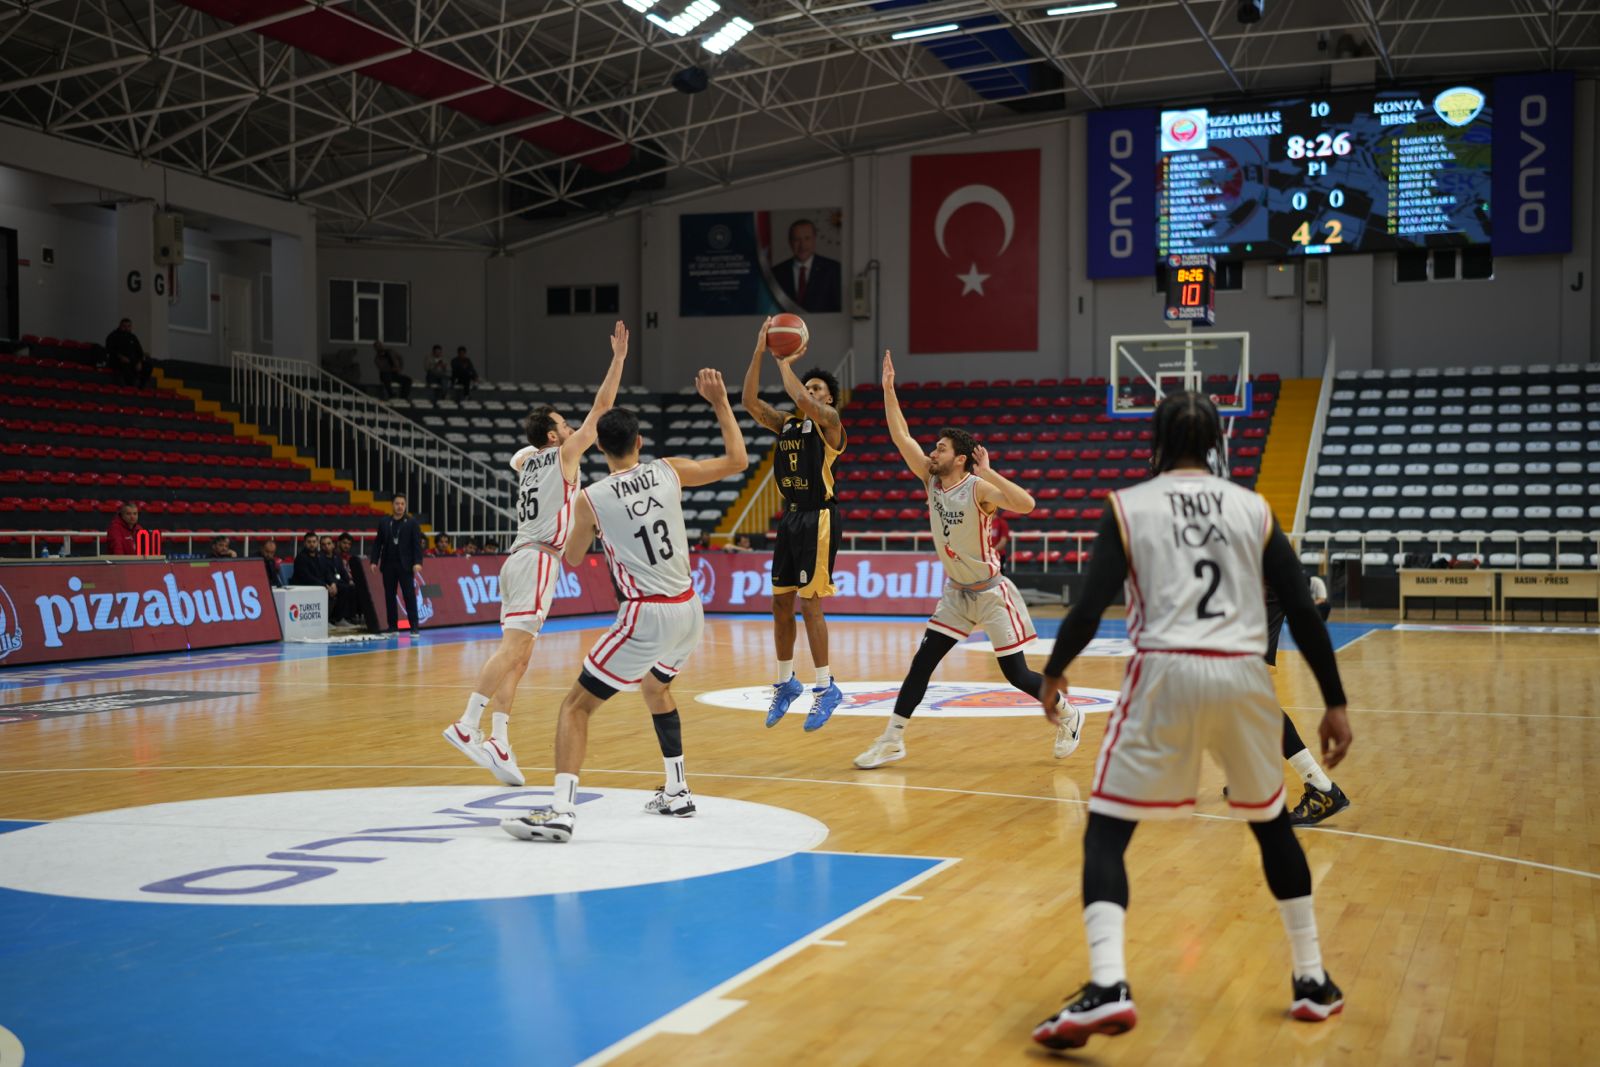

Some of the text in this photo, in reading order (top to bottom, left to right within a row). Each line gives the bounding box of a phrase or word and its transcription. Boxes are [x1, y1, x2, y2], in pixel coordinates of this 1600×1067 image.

[1310, 102, 1330, 117] 10
[1374, 100, 1424, 113] KONYA
[1381, 113, 1416, 126] BBSK
[1234, 123, 1282, 138] OSMAN
[1287, 132, 1351, 159] 8:26
[1308, 161, 1327, 175] P1
[1292, 189, 1344, 210] 0 0
[1291, 219, 1342, 245] 4 2
[127, 270, 142, 292] G
[155, 273, 165, 296] G
[1571, 272, 1584, 292] J
[1182, 284, 1200, 305] 10
[646, 312, 658, 329] H
[789, 453, 798, 471] 8
[610, 470, 659, 499] YAVUZ
[518, 487, 538, 522] 35
[634, 519, 674, 566] 13
[1194, 559, 1226, 620] 2
[1415, 577, 1437, 585] BASIN
[1444, 576, 1468, 585] PRESS
[1514, 576, 1537, 584] BASIN
[1544, 576, 1569, 585] PRESS
[35, 570, 262, 648] pizzabulls
